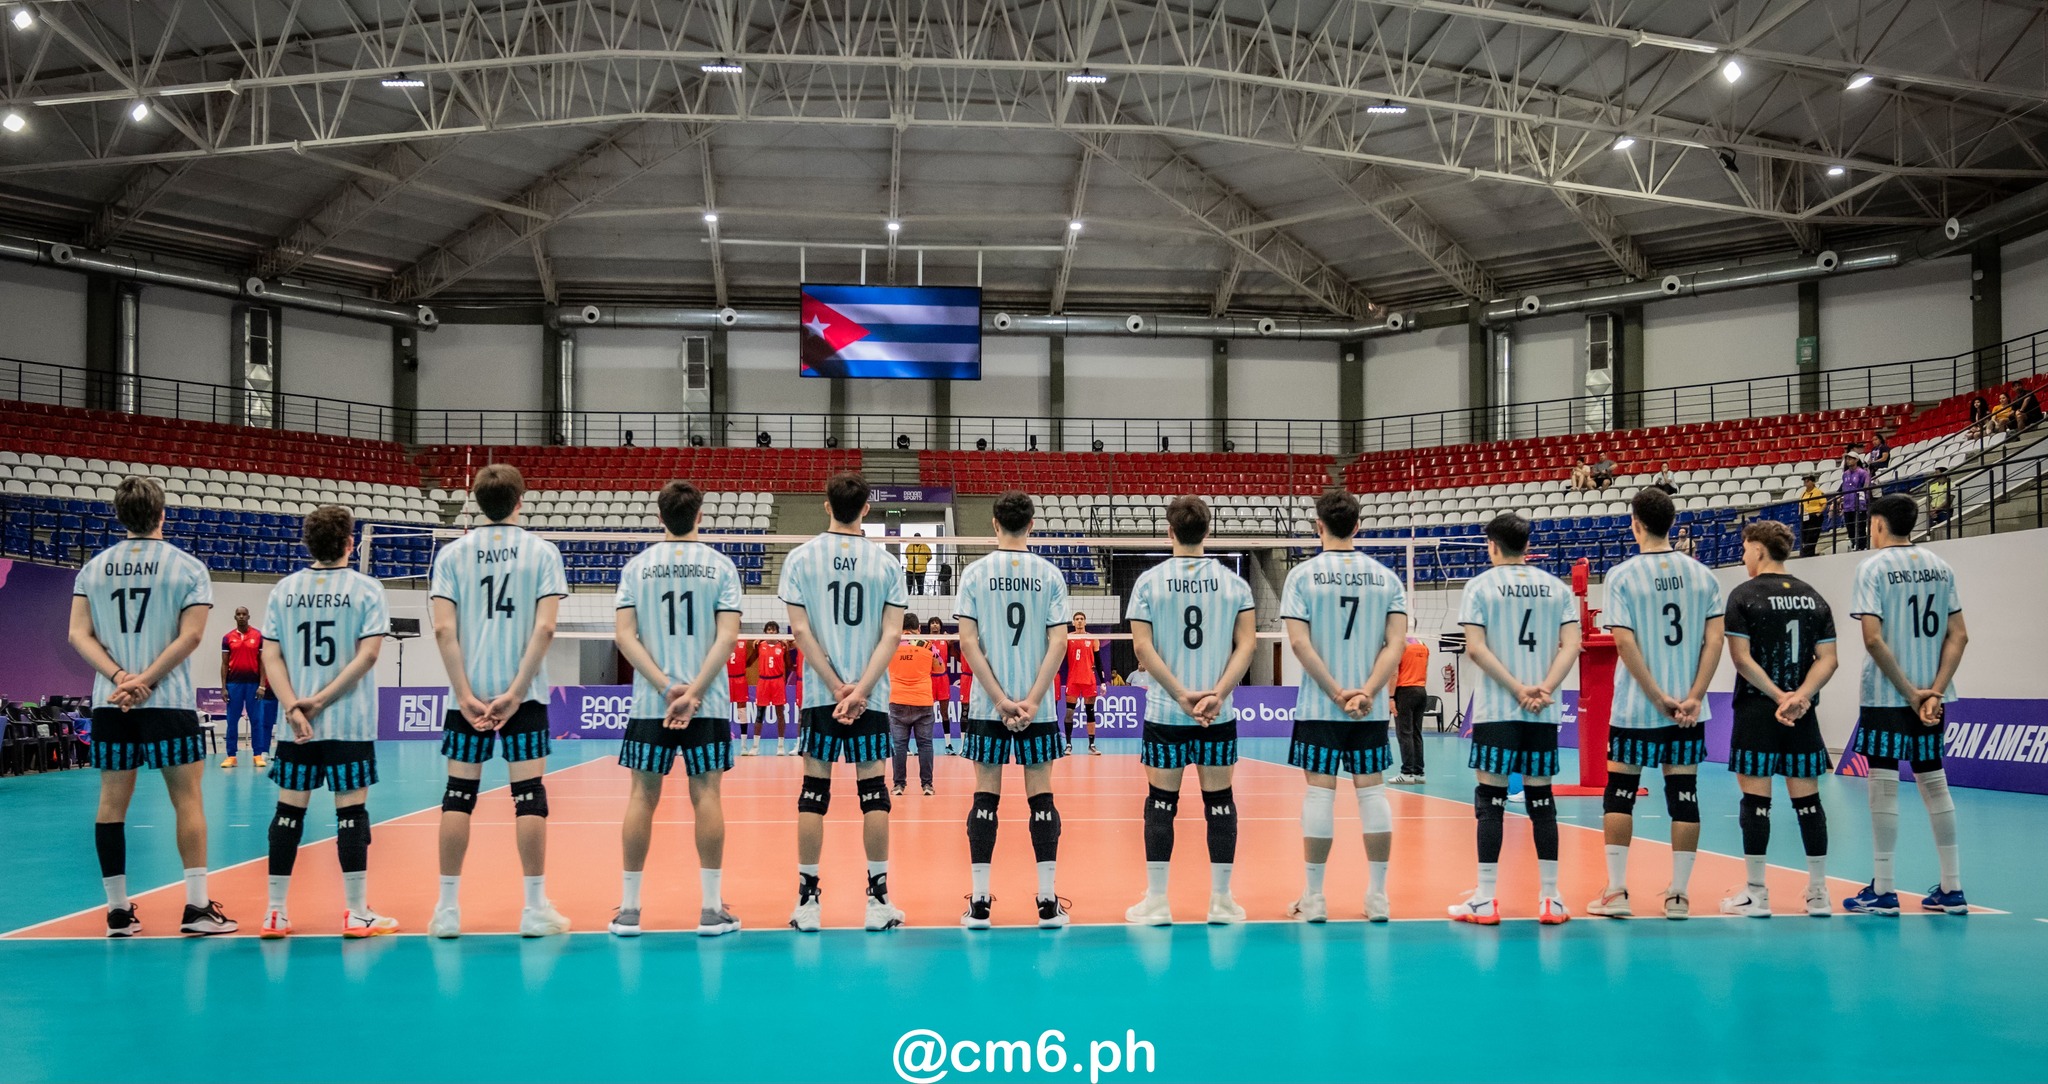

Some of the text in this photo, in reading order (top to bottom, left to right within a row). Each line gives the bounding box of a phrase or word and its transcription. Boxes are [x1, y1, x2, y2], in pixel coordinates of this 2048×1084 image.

[477, 547, 518, 564] PAVON
[833, 556, 858, 571] GAY
[105, 561, 159, 577] OLDANI
[642, 564, 716, 580] GARCIA RODRIGUEZ
[989, 577, 1042, 592] DEBONIS
[1313, 572, 1385, 587] ROJAS CASTILLO
[1654, 575, 1684, 591] GUIDI
[1887, 570, 1912, 585] DENIS
[1166, 578, 1218, 594] TURCITU
[1497, 584, 1553, 597] VAZQUEZ
[480, 573, 515, 619] 14
[827, 580, 864, 627] 10
[1767, 596, 1816, 610] TRUCCO
[111, 587, 151, 633] 17
[661, 590, 694, 636] 11
[1340, 596, 1360, 640] 7
[1907, 593, 1939, 638] 16
[1007, 601, 1026, 646] 9
[1183, 605, 1204, 650] 8
[1518, 608, 1537, 652] 4
[1662, 603, 1684, 646] 3
[296, 620, 336, 667] 15
[1785, 619, 1800, 663] 1
[730, 652, 736, 664] 2
[768, 656, 774, 668] 5
[1075, 649, 1081, 660] 6
[1944, 722, 1988, 759] PAN
[976, 809, 994, 821] N1
[1035, 810, 1052, 821] N1
[1211, 804, 1231, 816] N1
